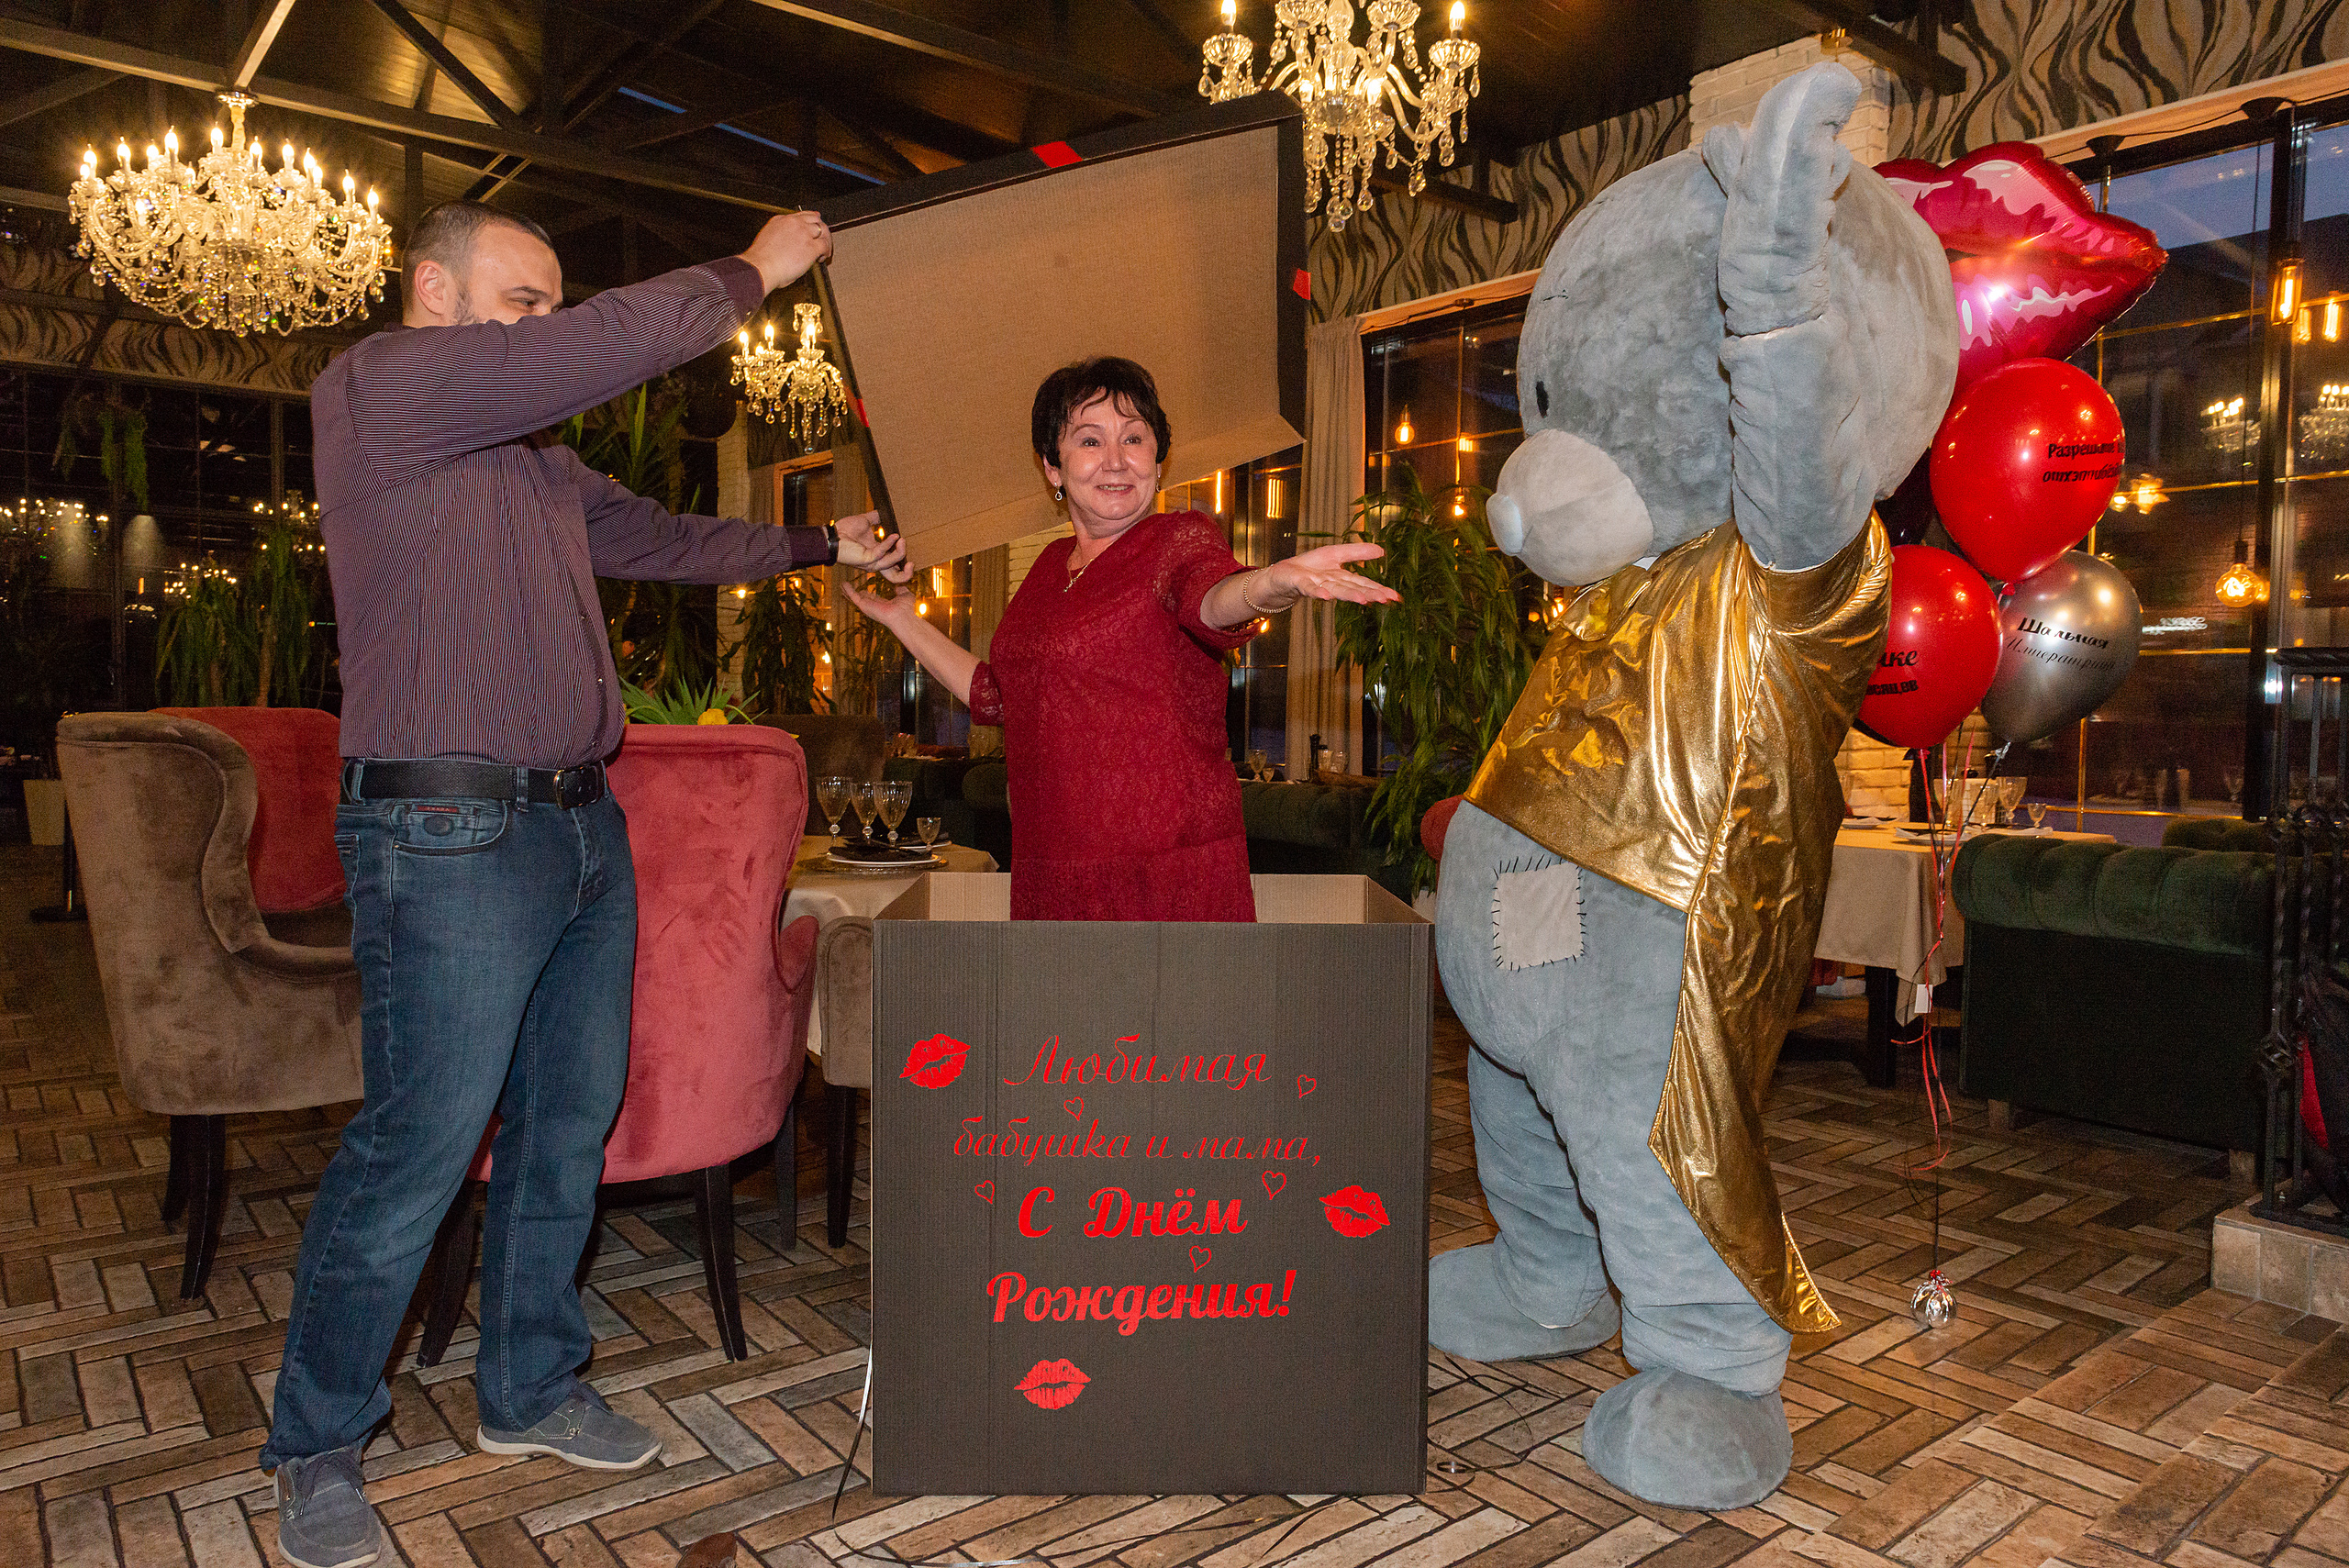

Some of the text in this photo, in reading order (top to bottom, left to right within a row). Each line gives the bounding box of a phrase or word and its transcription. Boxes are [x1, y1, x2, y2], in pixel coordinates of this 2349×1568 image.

[1003, 1032, 1273, 1091] Любимая
[953, 1115, 1320, 1167] бабушка и мама,
[1018, 1185, 1249, 1239] С Днём
[985, 1269, 1297, 1337] Рождения!
